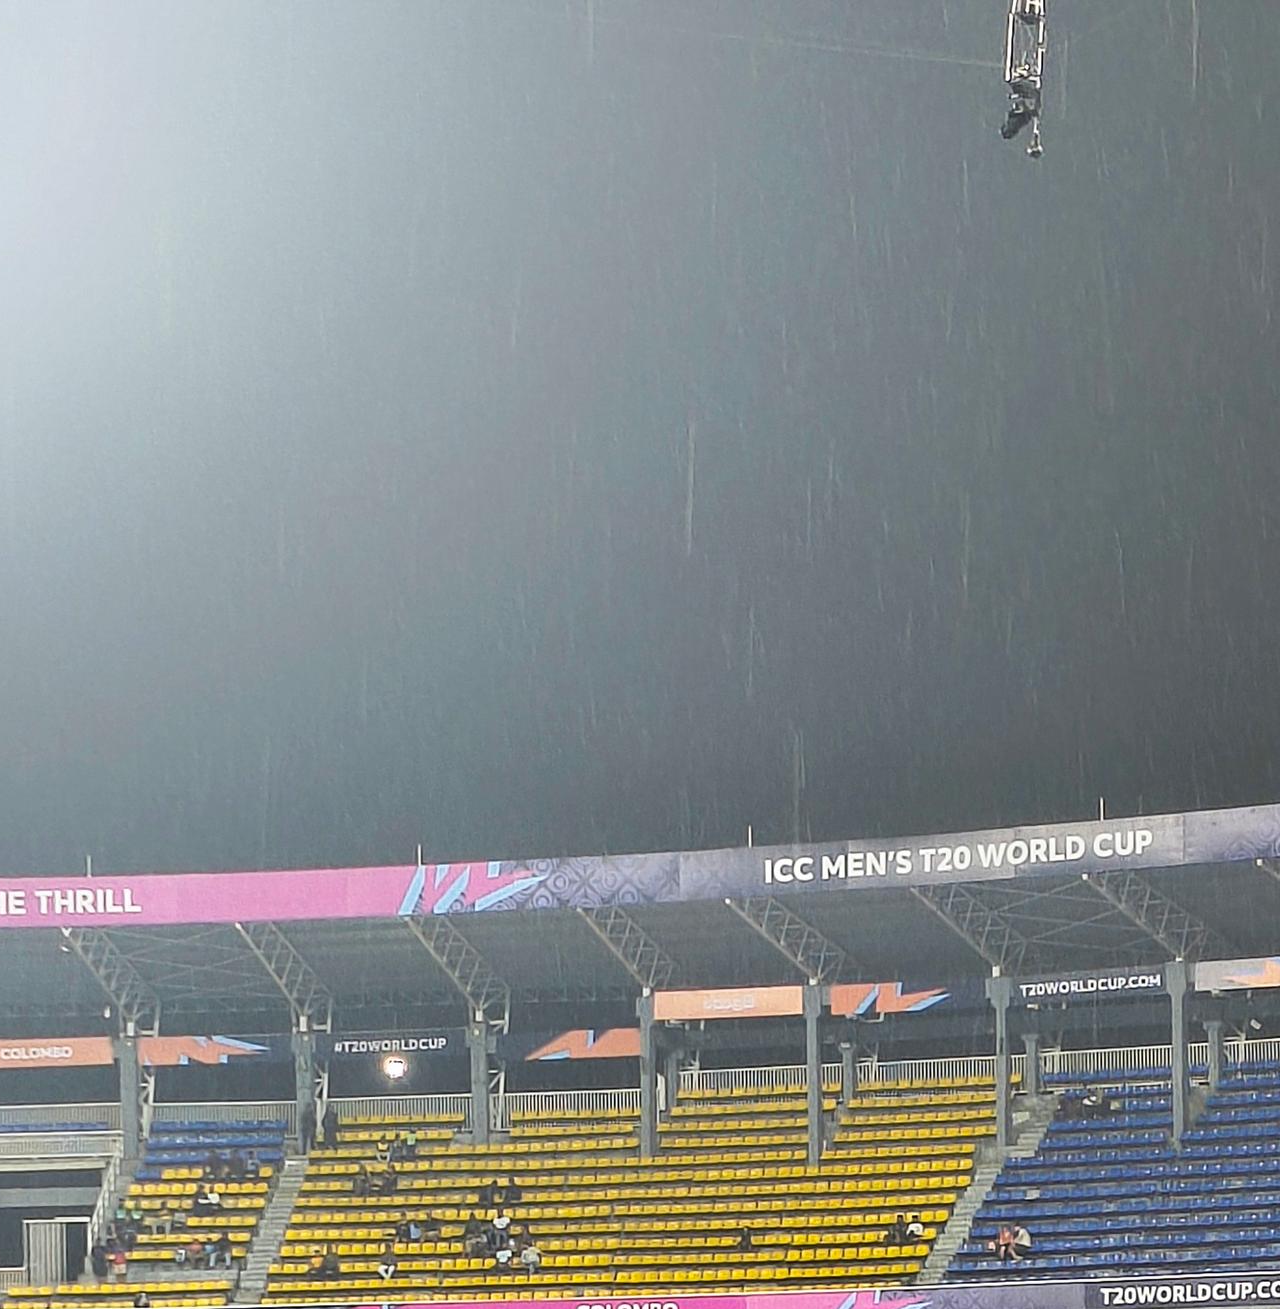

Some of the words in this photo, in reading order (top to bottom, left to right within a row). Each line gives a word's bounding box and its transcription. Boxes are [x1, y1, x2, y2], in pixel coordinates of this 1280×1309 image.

[765, 857, 813, 883] ICC
[822, 847, 912, 880] MEN'S
[920, 846, 970, 871] T20
[978, 835, 1086, 866] WORLD
[1094, 831, 1152, 858] CUP
[34, 888, 141, 914] THRILL
[1019, 975, 1161, 998] T20WORLDCUP.COM
[334, 1037, 447, 1052] #T20WORLDCUP
